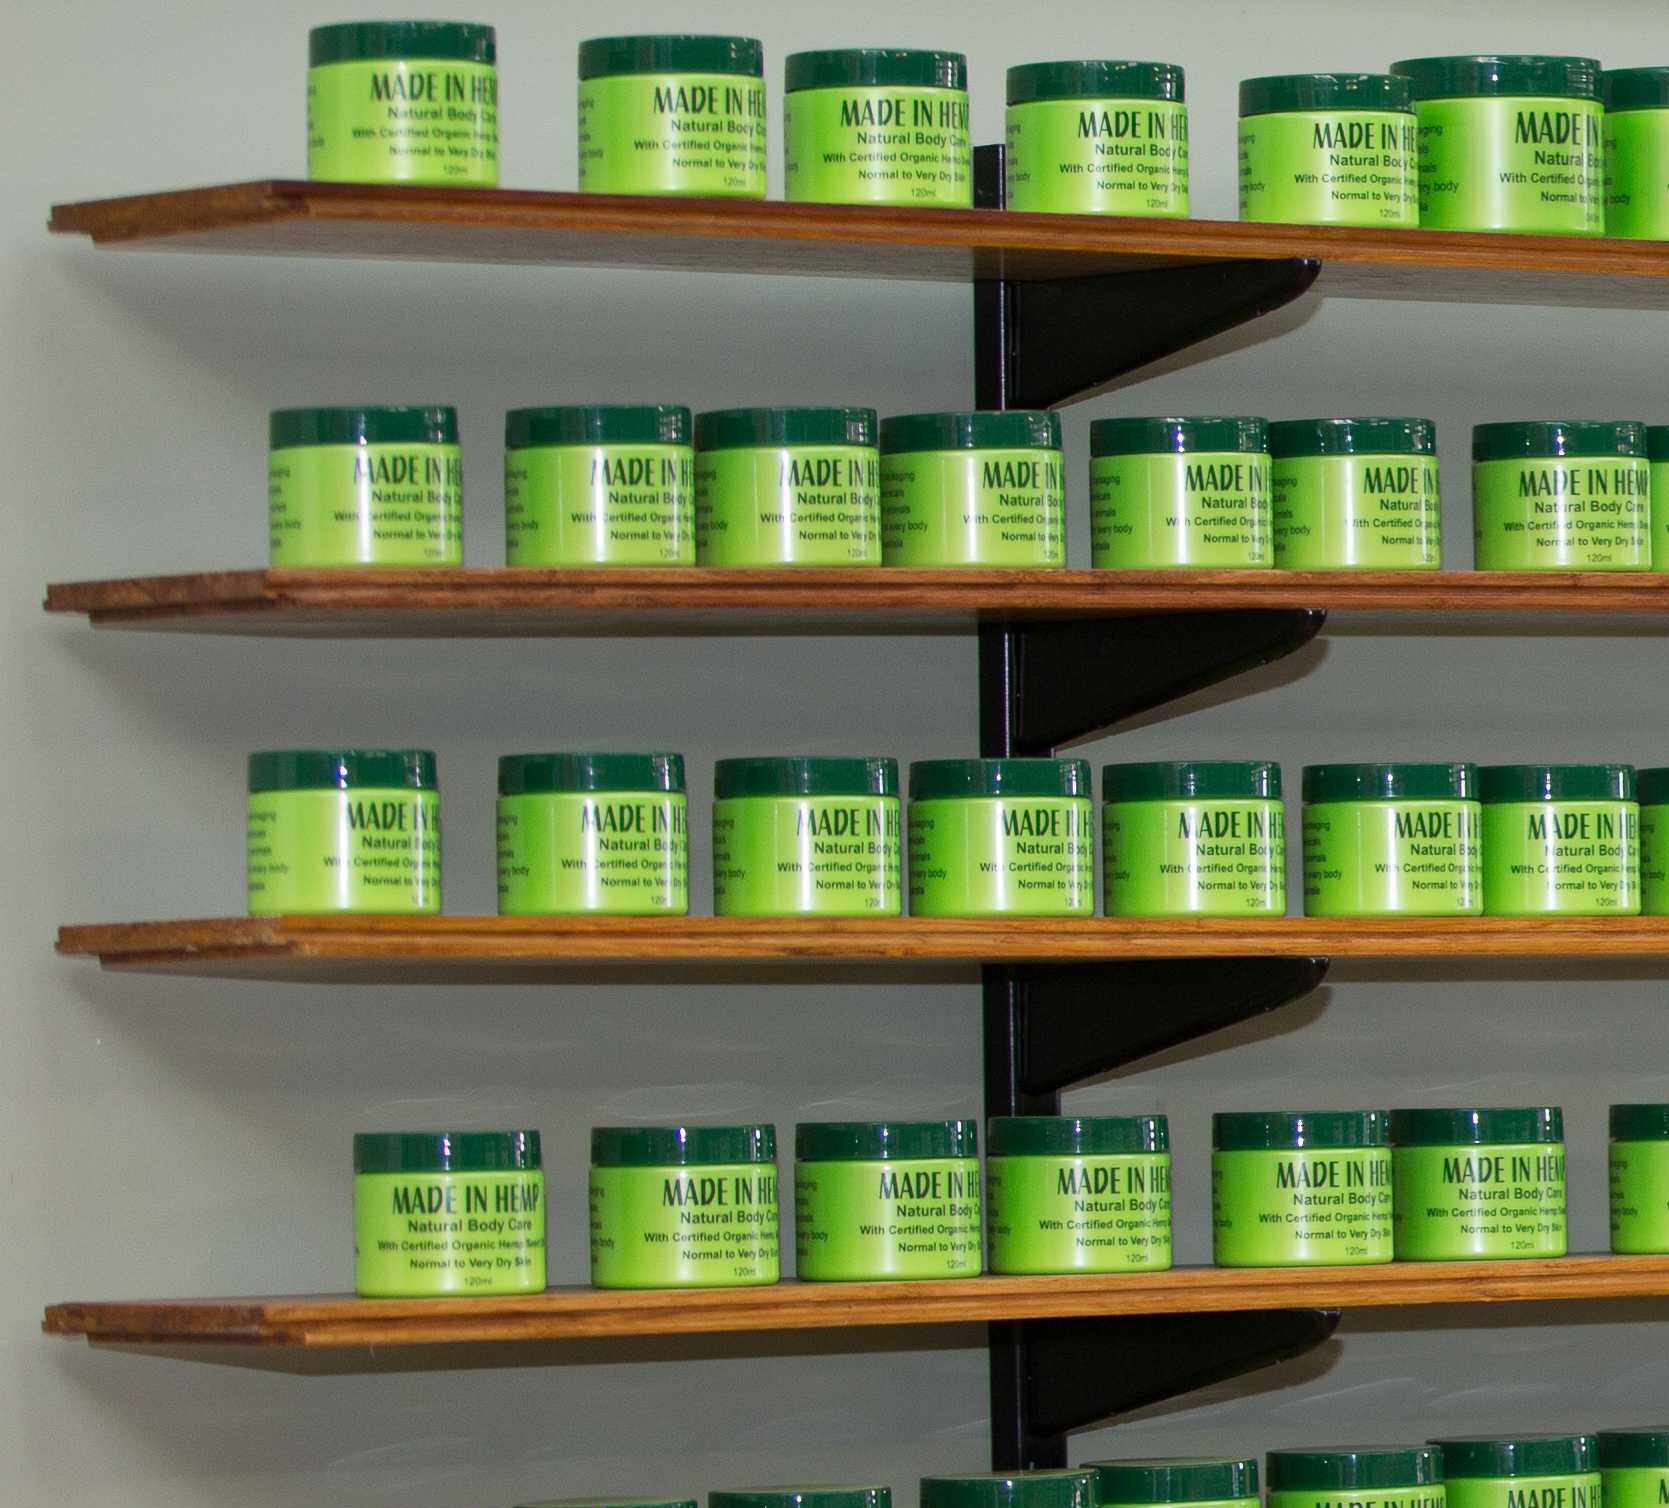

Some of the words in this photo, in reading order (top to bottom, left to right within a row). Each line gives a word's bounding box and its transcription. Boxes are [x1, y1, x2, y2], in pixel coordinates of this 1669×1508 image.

[841, 99, 906, 127] MADE
[913, 99, 932, 127] IN
[1519, 471, 1579, 499] MADE
[1587, 472, 1609, 499] IN
[392, 1184, 457, 1215] MADE
[464, 1184, 488, 1214] IN
[408, 1219, 463, 1234] Natural
[467, 1219, 505, 1236] Body
[508, 1219, 532, 1233] Care
